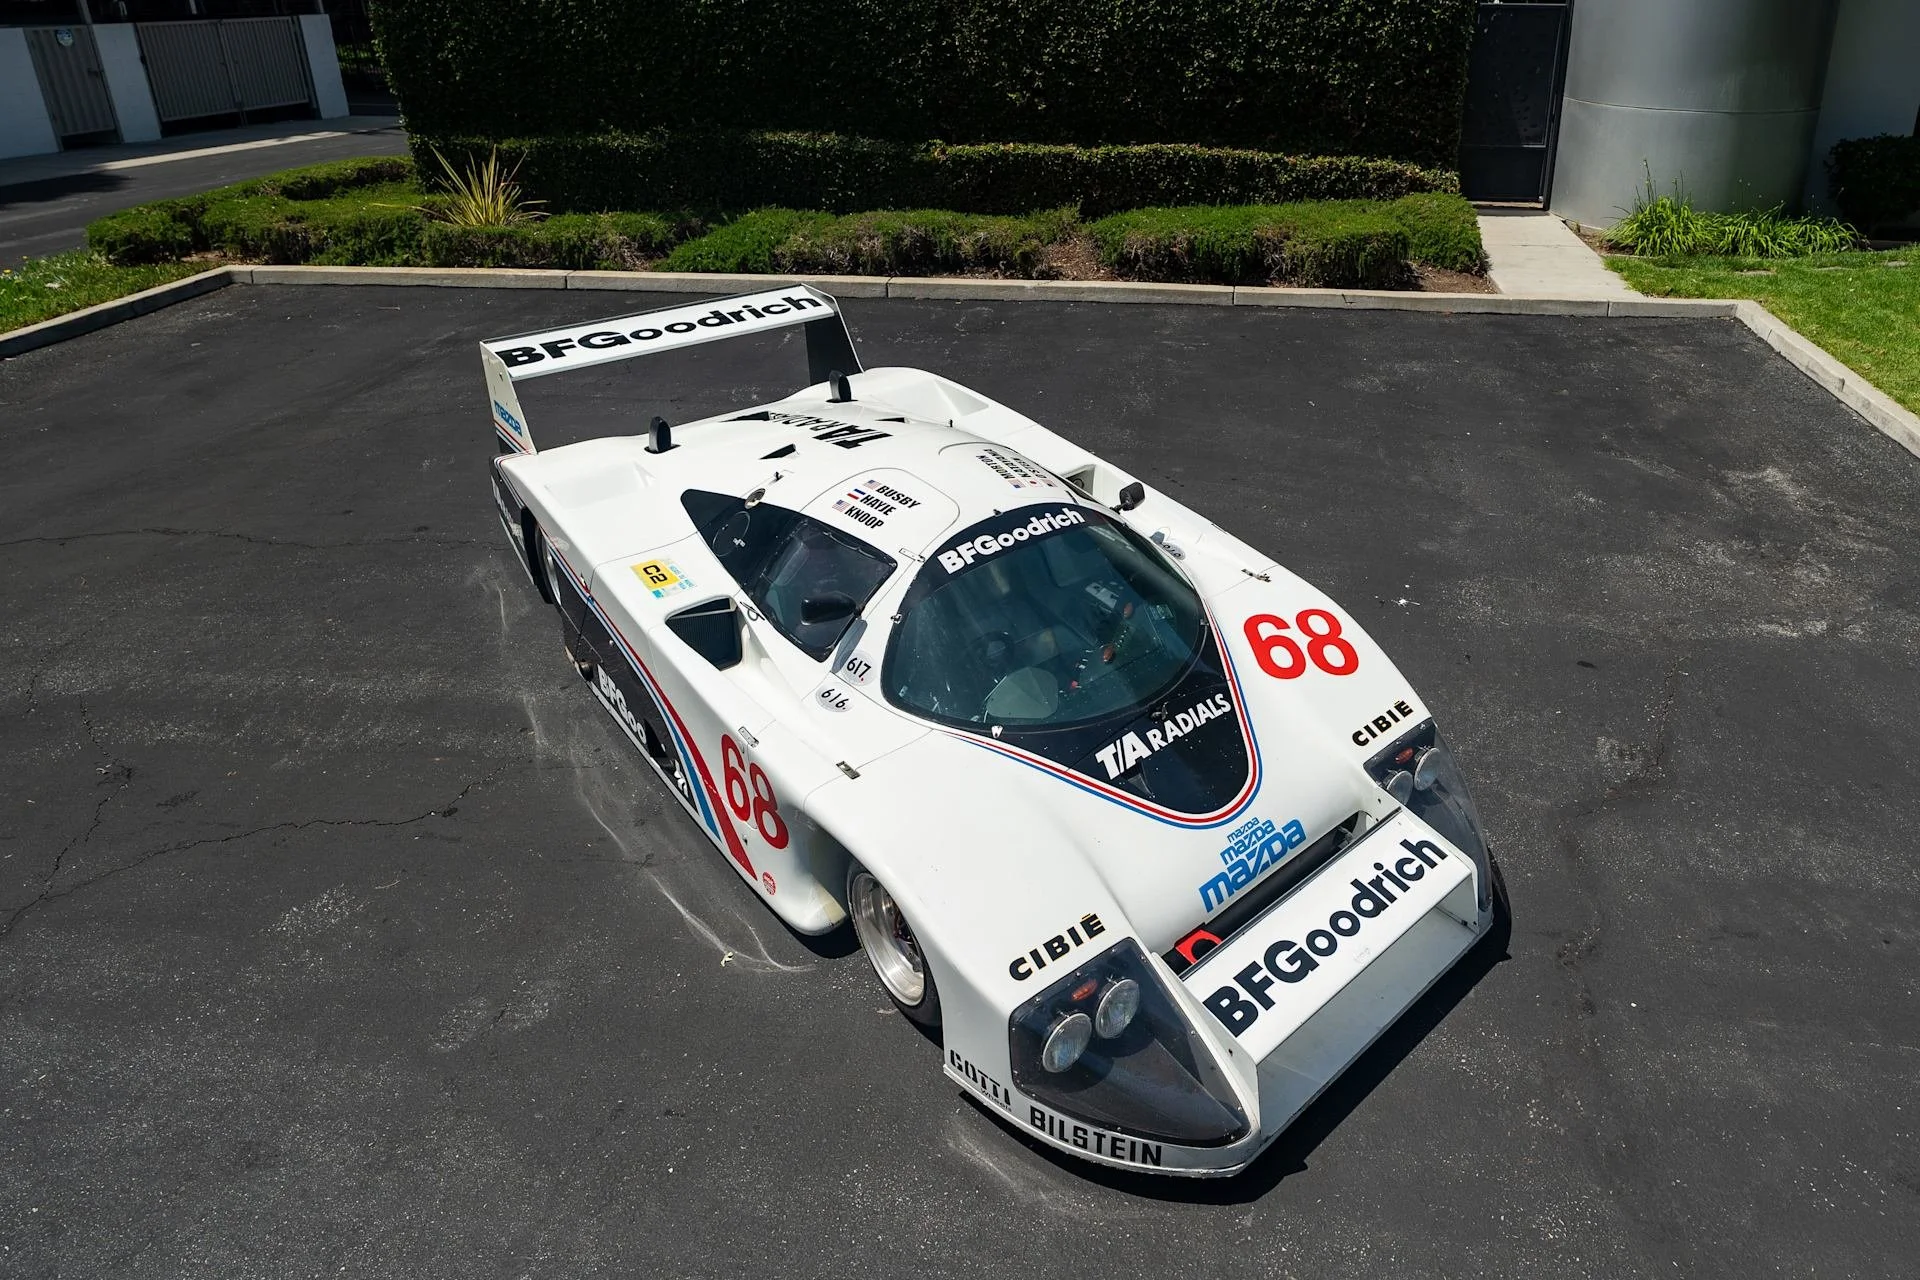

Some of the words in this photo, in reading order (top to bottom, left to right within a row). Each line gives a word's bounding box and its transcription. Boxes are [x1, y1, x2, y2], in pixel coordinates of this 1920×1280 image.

[495, 296, 821, 368] BFGoodrich
[844, 505, 885, 529] KNOOP
[860, 494, 897, 516] HAYJE
[875, 485, 922, 509] BUSBY
[937, 507, 1086, 575] BFGoodrich
[642, 564, 668, 585] C2
[1243, 608, 1360, 680] 68
[1095, 731, 1153, 780] T/A
[1146, 693, 1232, 752] RADIALS
[721, 733, 790, 850] 68
[1219, 818, 1276, 866] mazda
[1226, 816, 1260, 844] mazda
[1198, 818, 1307, 913] mazda
[1203, 838, 1449, 1039] BFGoodrich
[950, 1048, 1012, 1107] GOTTI
[1029, 1104, 1162, 1168] BILSTEIN
